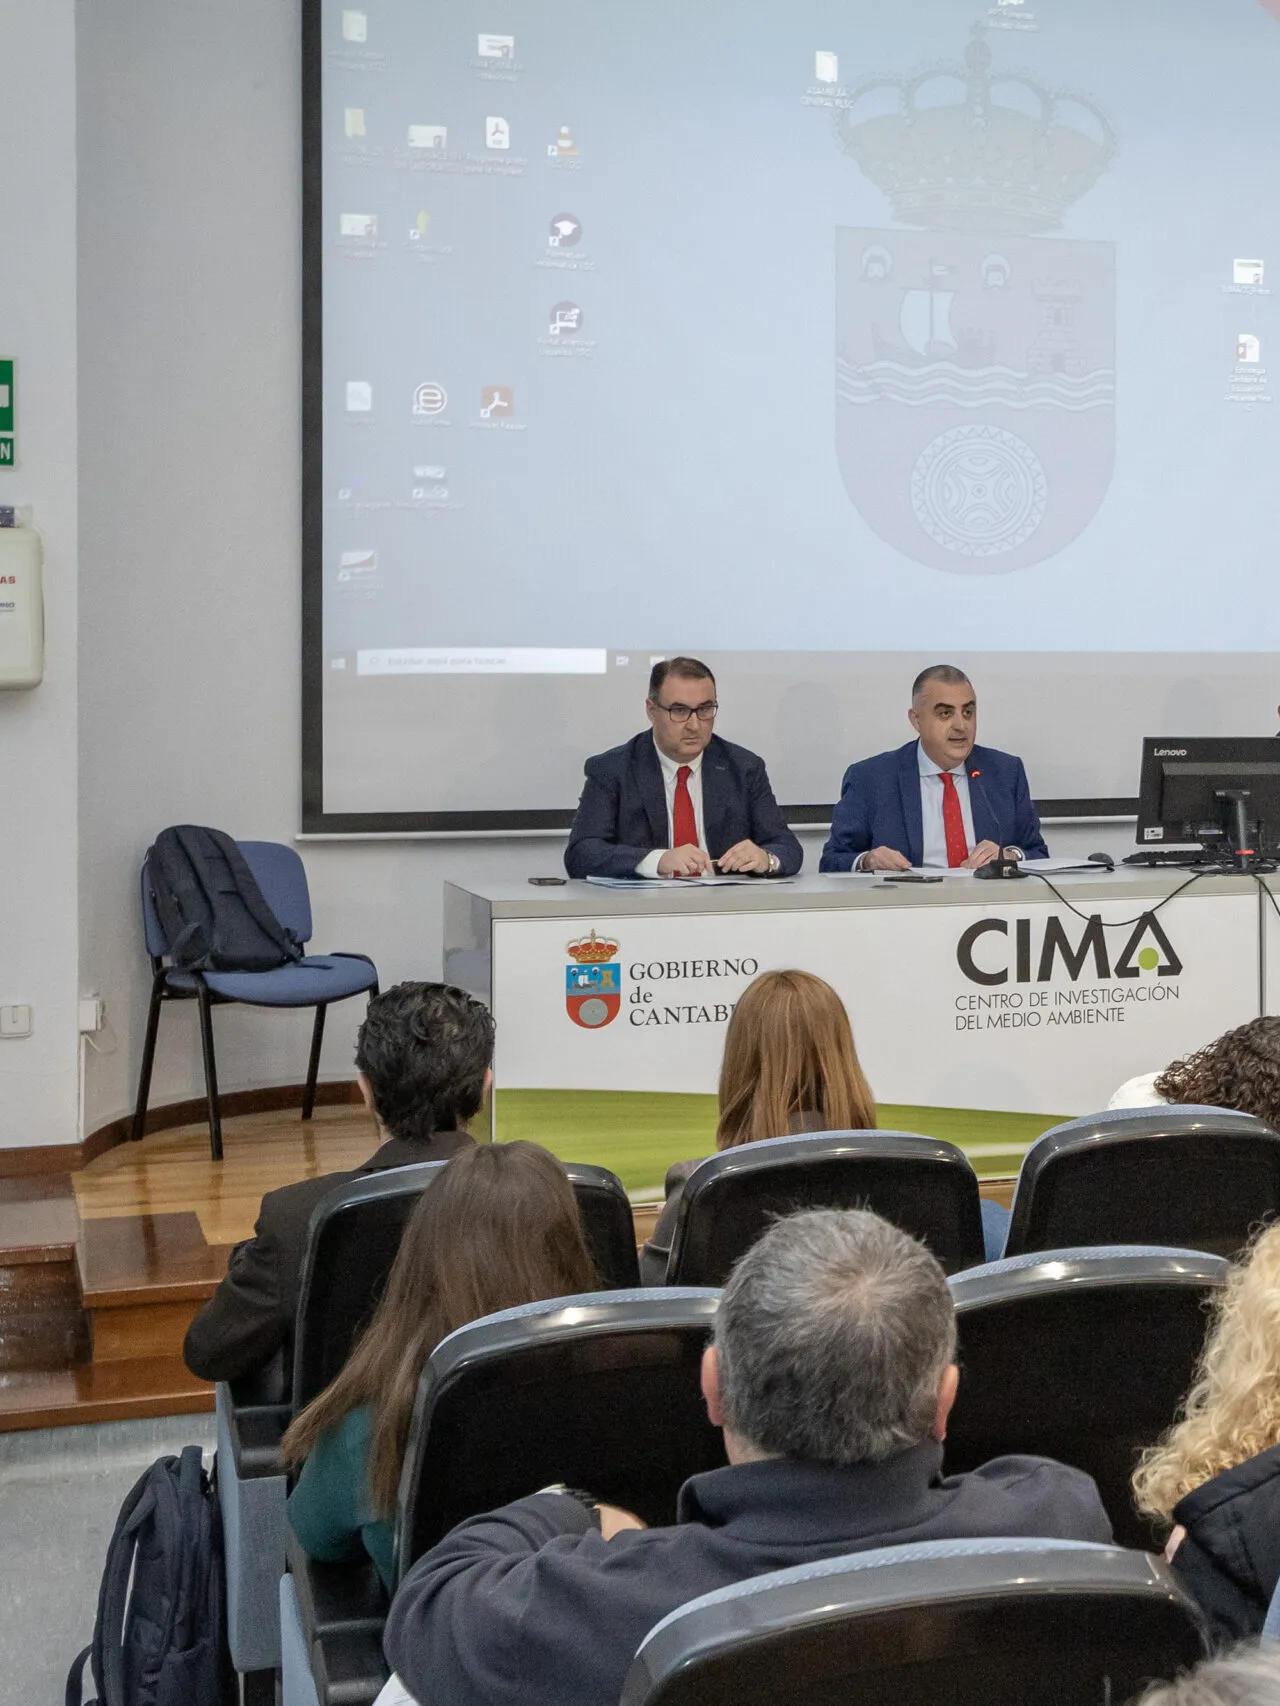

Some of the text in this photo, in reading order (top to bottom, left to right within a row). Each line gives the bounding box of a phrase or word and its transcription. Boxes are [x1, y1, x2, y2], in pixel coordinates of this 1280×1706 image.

[1153, 747, 1188, 757] Lenovo
[956, 910, 1183, 987] CIMA
[629, 957, 759, 981] GOBIERNO
[629, 985, 654, 1004] de
[955, 982, 1180, 1011] CENTRO DE INVESTIGACIÓN
[629, 1003, 737, 1027] CANTAB
[955, 1007, 1126, 1031] DEL MEDIO AMBIENTE
